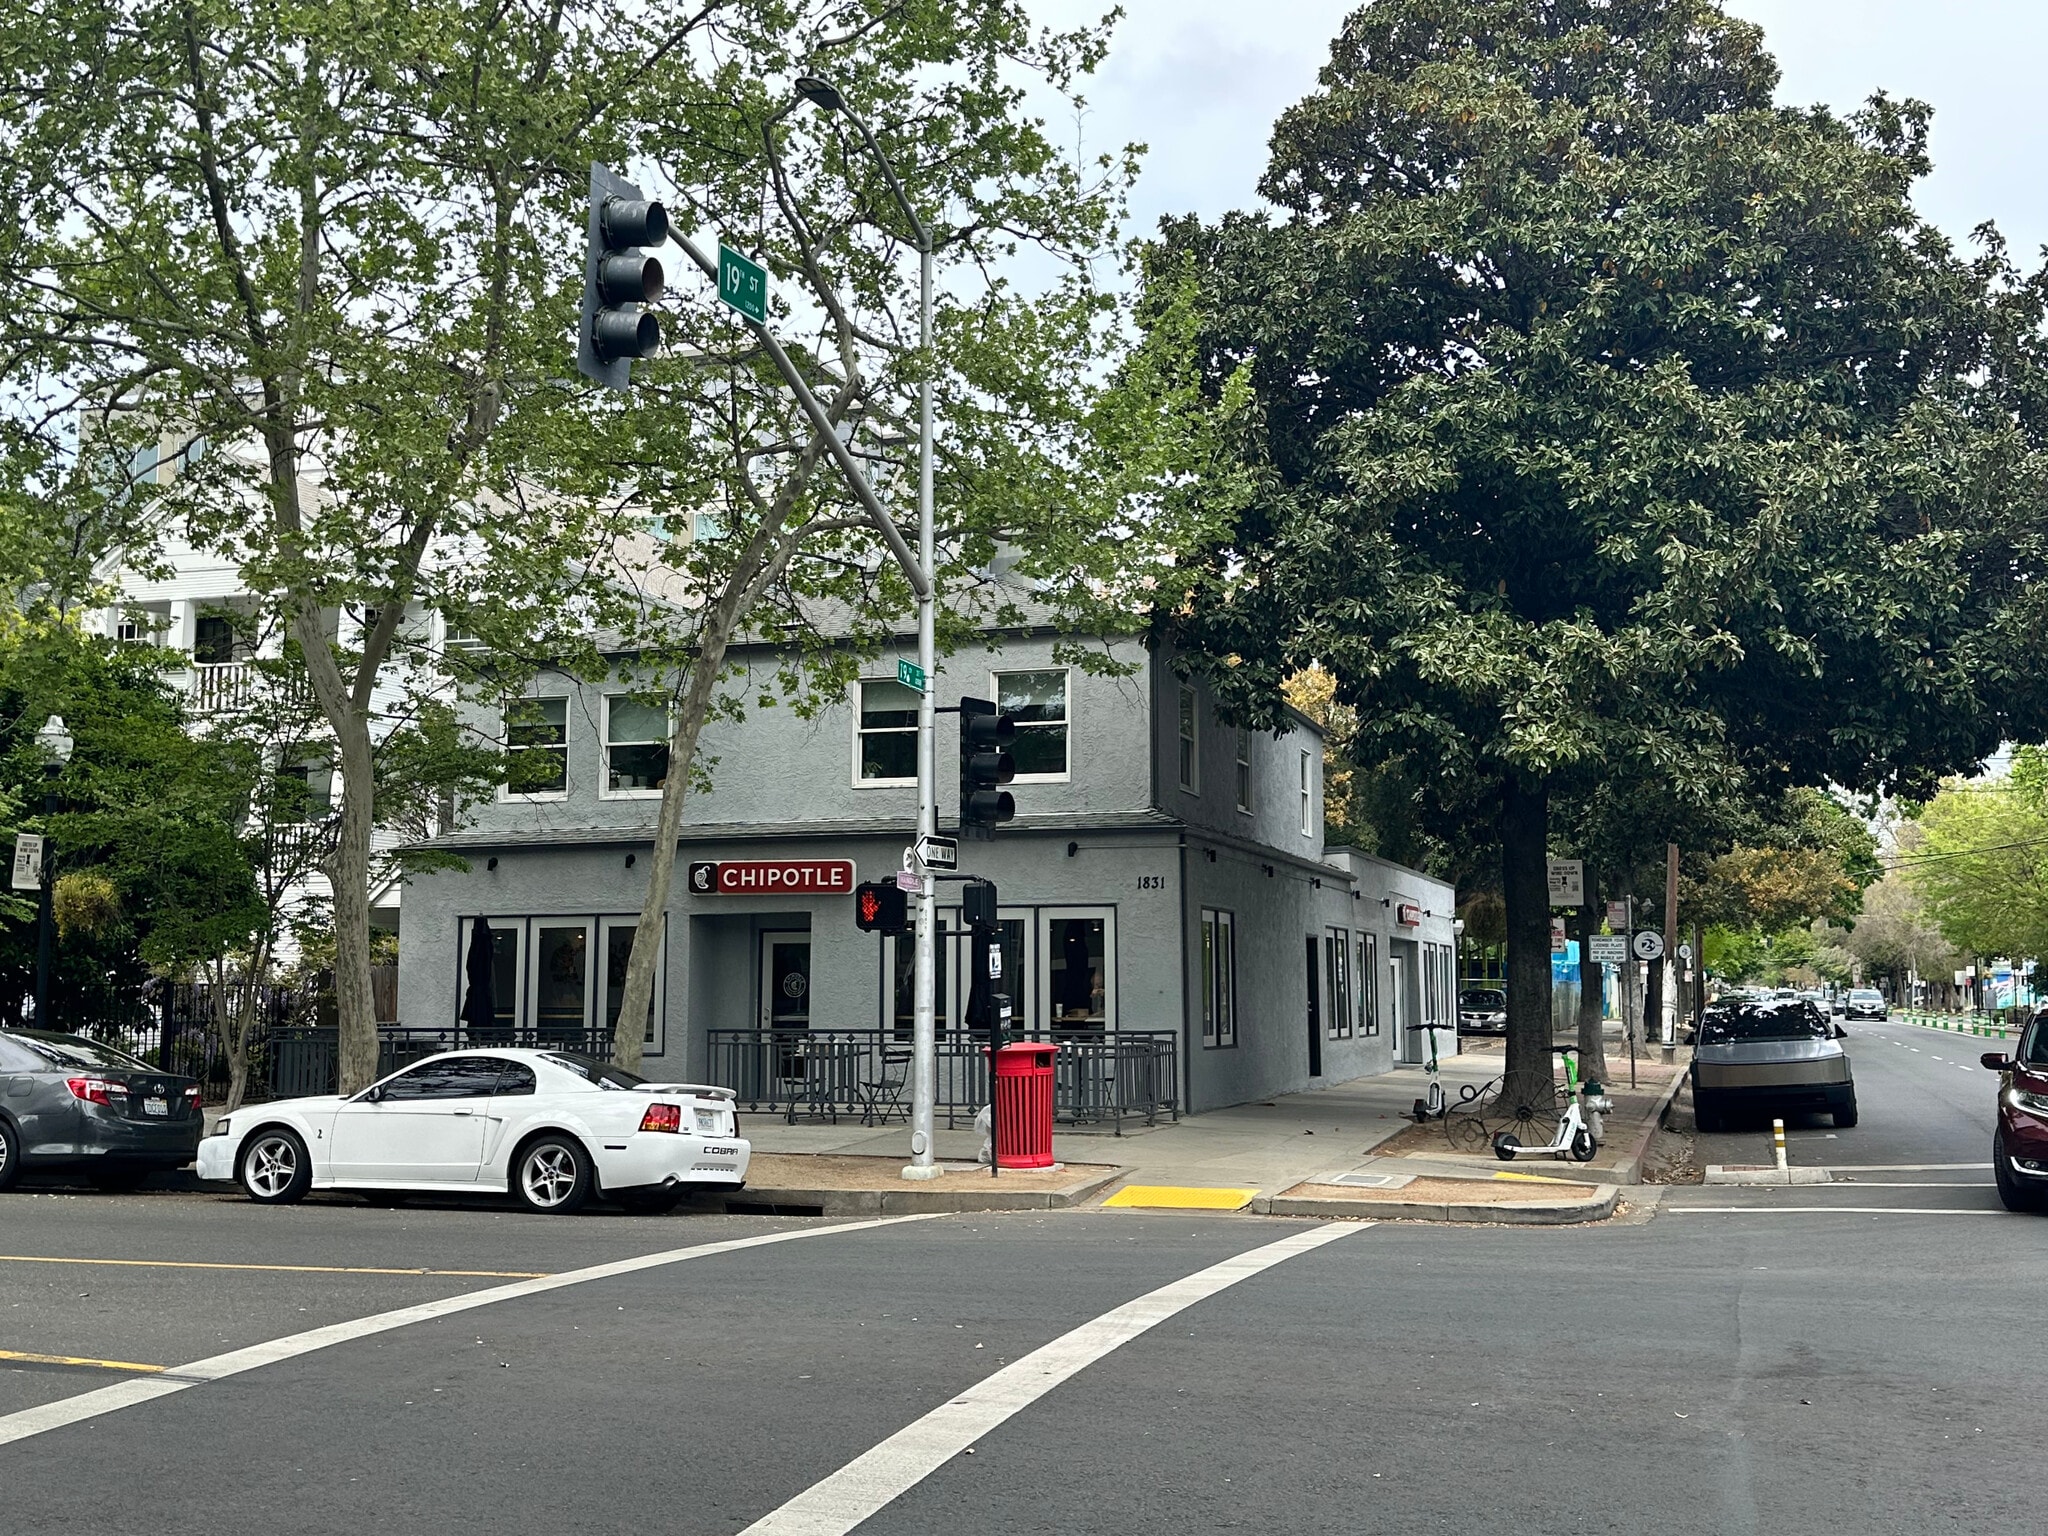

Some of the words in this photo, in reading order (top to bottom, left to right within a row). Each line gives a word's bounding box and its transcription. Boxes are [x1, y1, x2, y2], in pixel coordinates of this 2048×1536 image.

[749, 276, 759, 293] ST
[927, 845, 939, 859] ONE
[941, 847, 955, 861] WAY
[723, 868, 844, 887] CHIPOTLE
[1137, 876, 1165, 890] 1831
[703, 1146, 739, 1155] COBRA
